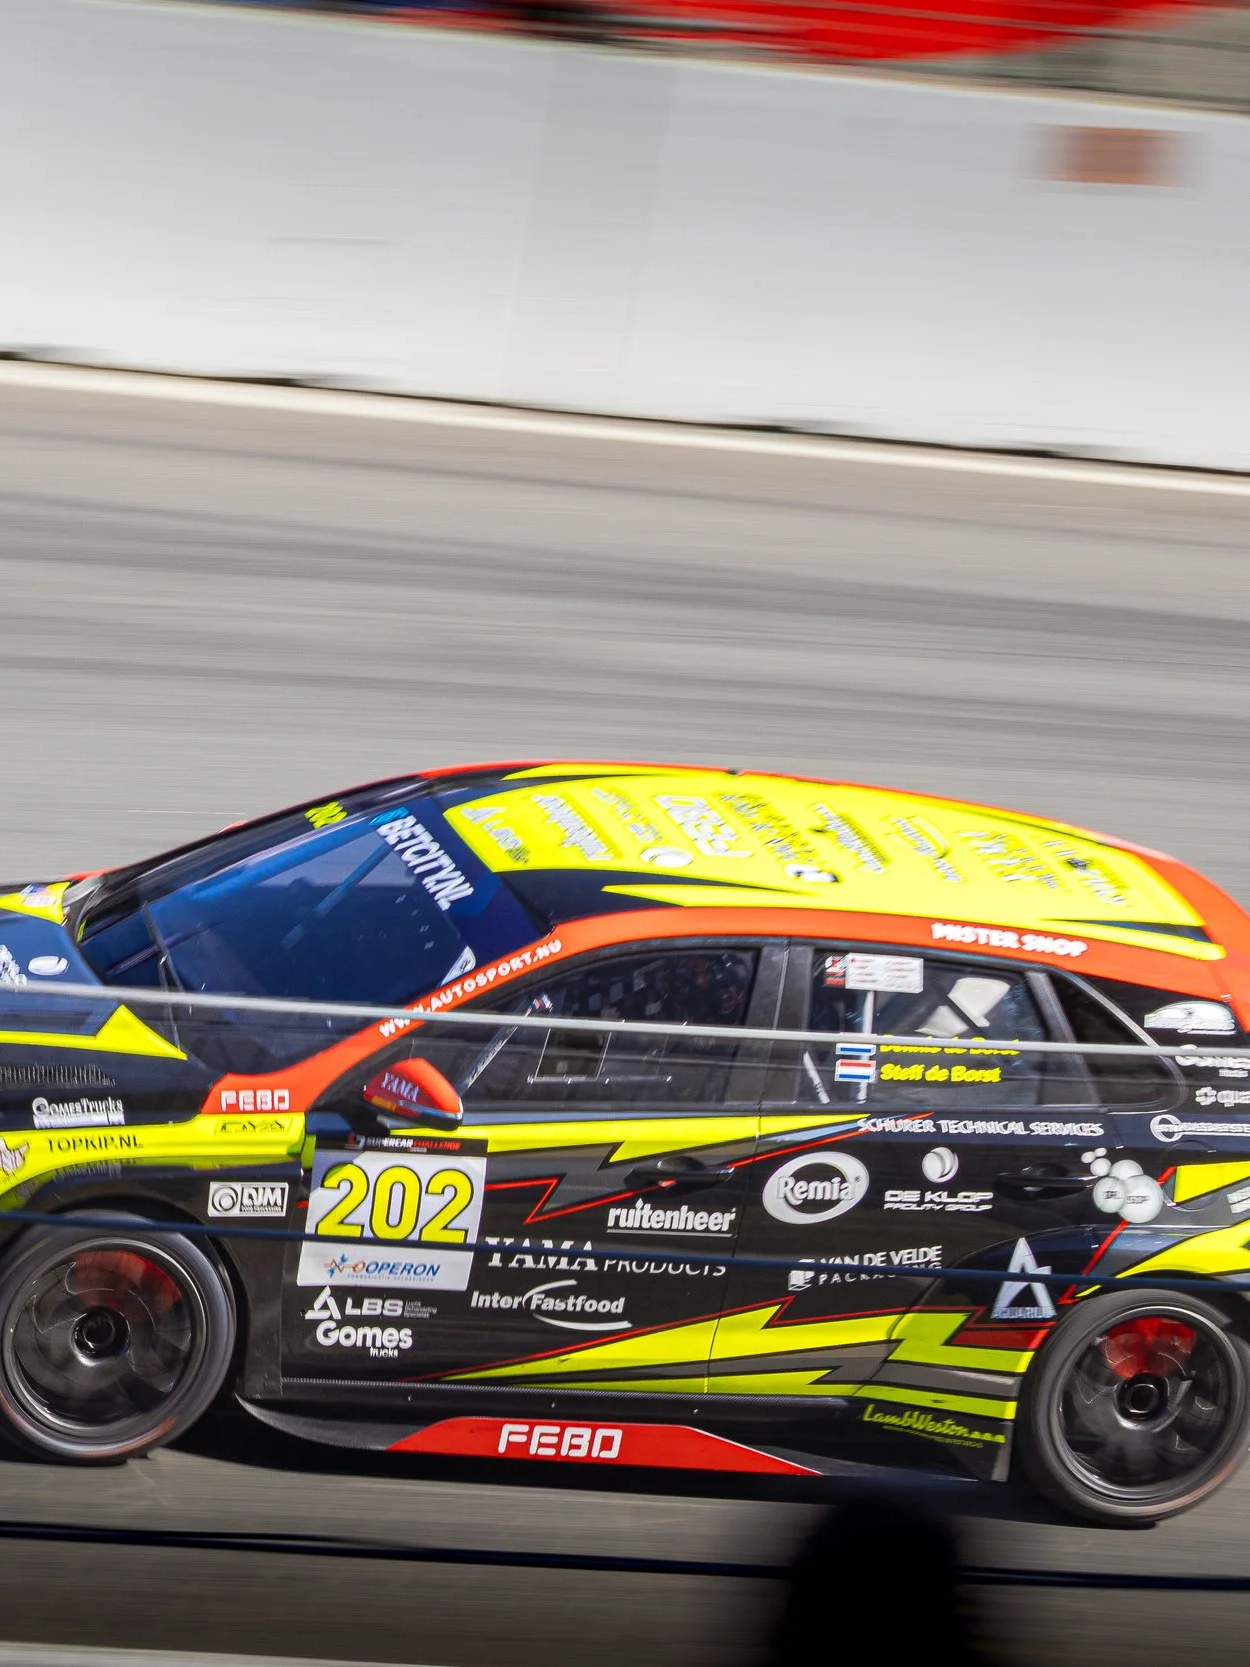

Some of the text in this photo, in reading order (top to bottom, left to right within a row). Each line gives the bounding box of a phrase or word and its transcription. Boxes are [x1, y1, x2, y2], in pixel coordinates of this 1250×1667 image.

[931, 922, 1088, 957] MISTER SHOP
[925, 1064, 949, 1081] de
[221, 1089, 290, 1111] FEBO
[381, 1072, 419, 1102] YAMA
[857, 1117, 1105, 1137] SCHURER TECHNICAL SERVICES
[46, 1133, 144, 1153] TOPKIP.NL
[316, 1162, 475, 1243] 202
[777, 1176, 855, 1206] Remia
[884, 1190, 993, 1203] DE KLOP
[607, 1198, 736, 1231] ruitenheer
[485, 1236, 598, 1272] YAMA
[863, 1251, 887, 1267] DE
[889, 1245, 943, 1266] VELDE
[345, 1297, 404, 1317] LBS
[471, 1291, 626, 1314] Inter Fastfood
[316, 1320, 413, 1349] Gomes
[498, 1423, 623, 1459] FEBO
